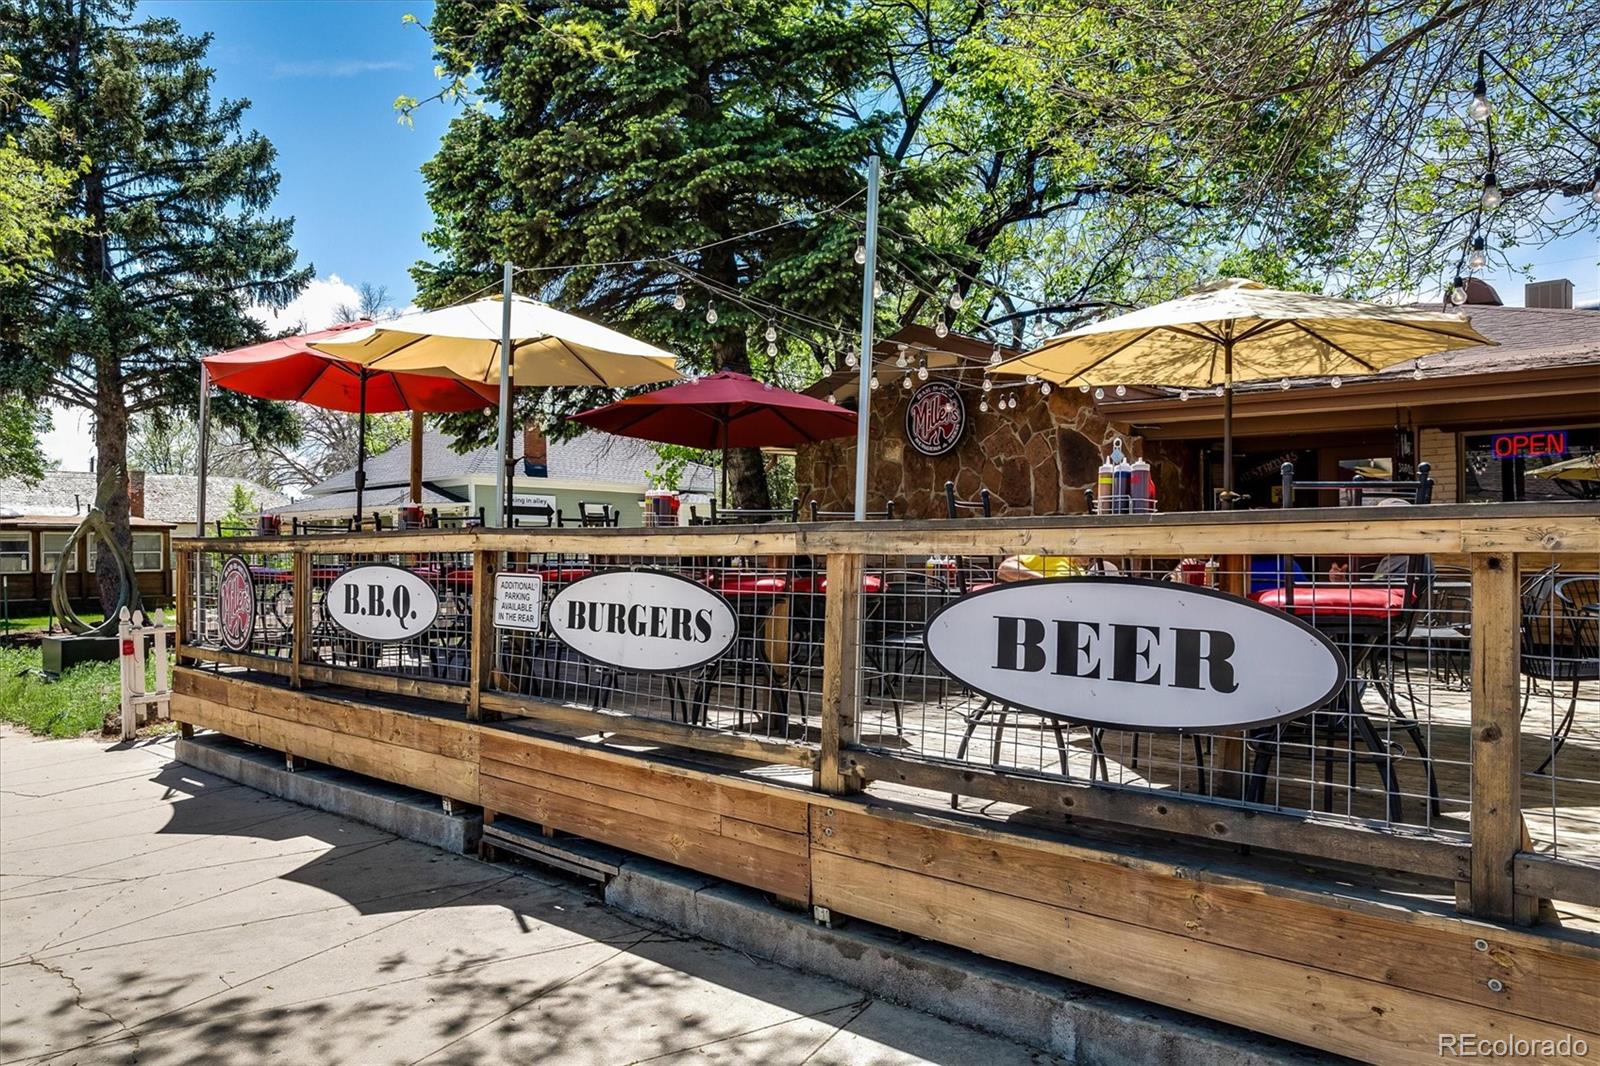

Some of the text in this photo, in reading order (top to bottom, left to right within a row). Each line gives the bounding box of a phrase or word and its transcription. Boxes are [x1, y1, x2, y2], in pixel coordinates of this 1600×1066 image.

[1495, 432, 1564, 457] OPEN
[532, 497, 547, 506] alley
[500, 581, 535, 591] ADDITIONAL
[504, 591, 530, 601] PARKING
[343, 583, 417, 630] B.B.Q.
[501, 602, 532, 612] AVAILABLE
[498, 612, 535, 622] IN THE REAR
[566, 600, 713, 643] BURGERS
[991, 615, 1239, 694] BEER
